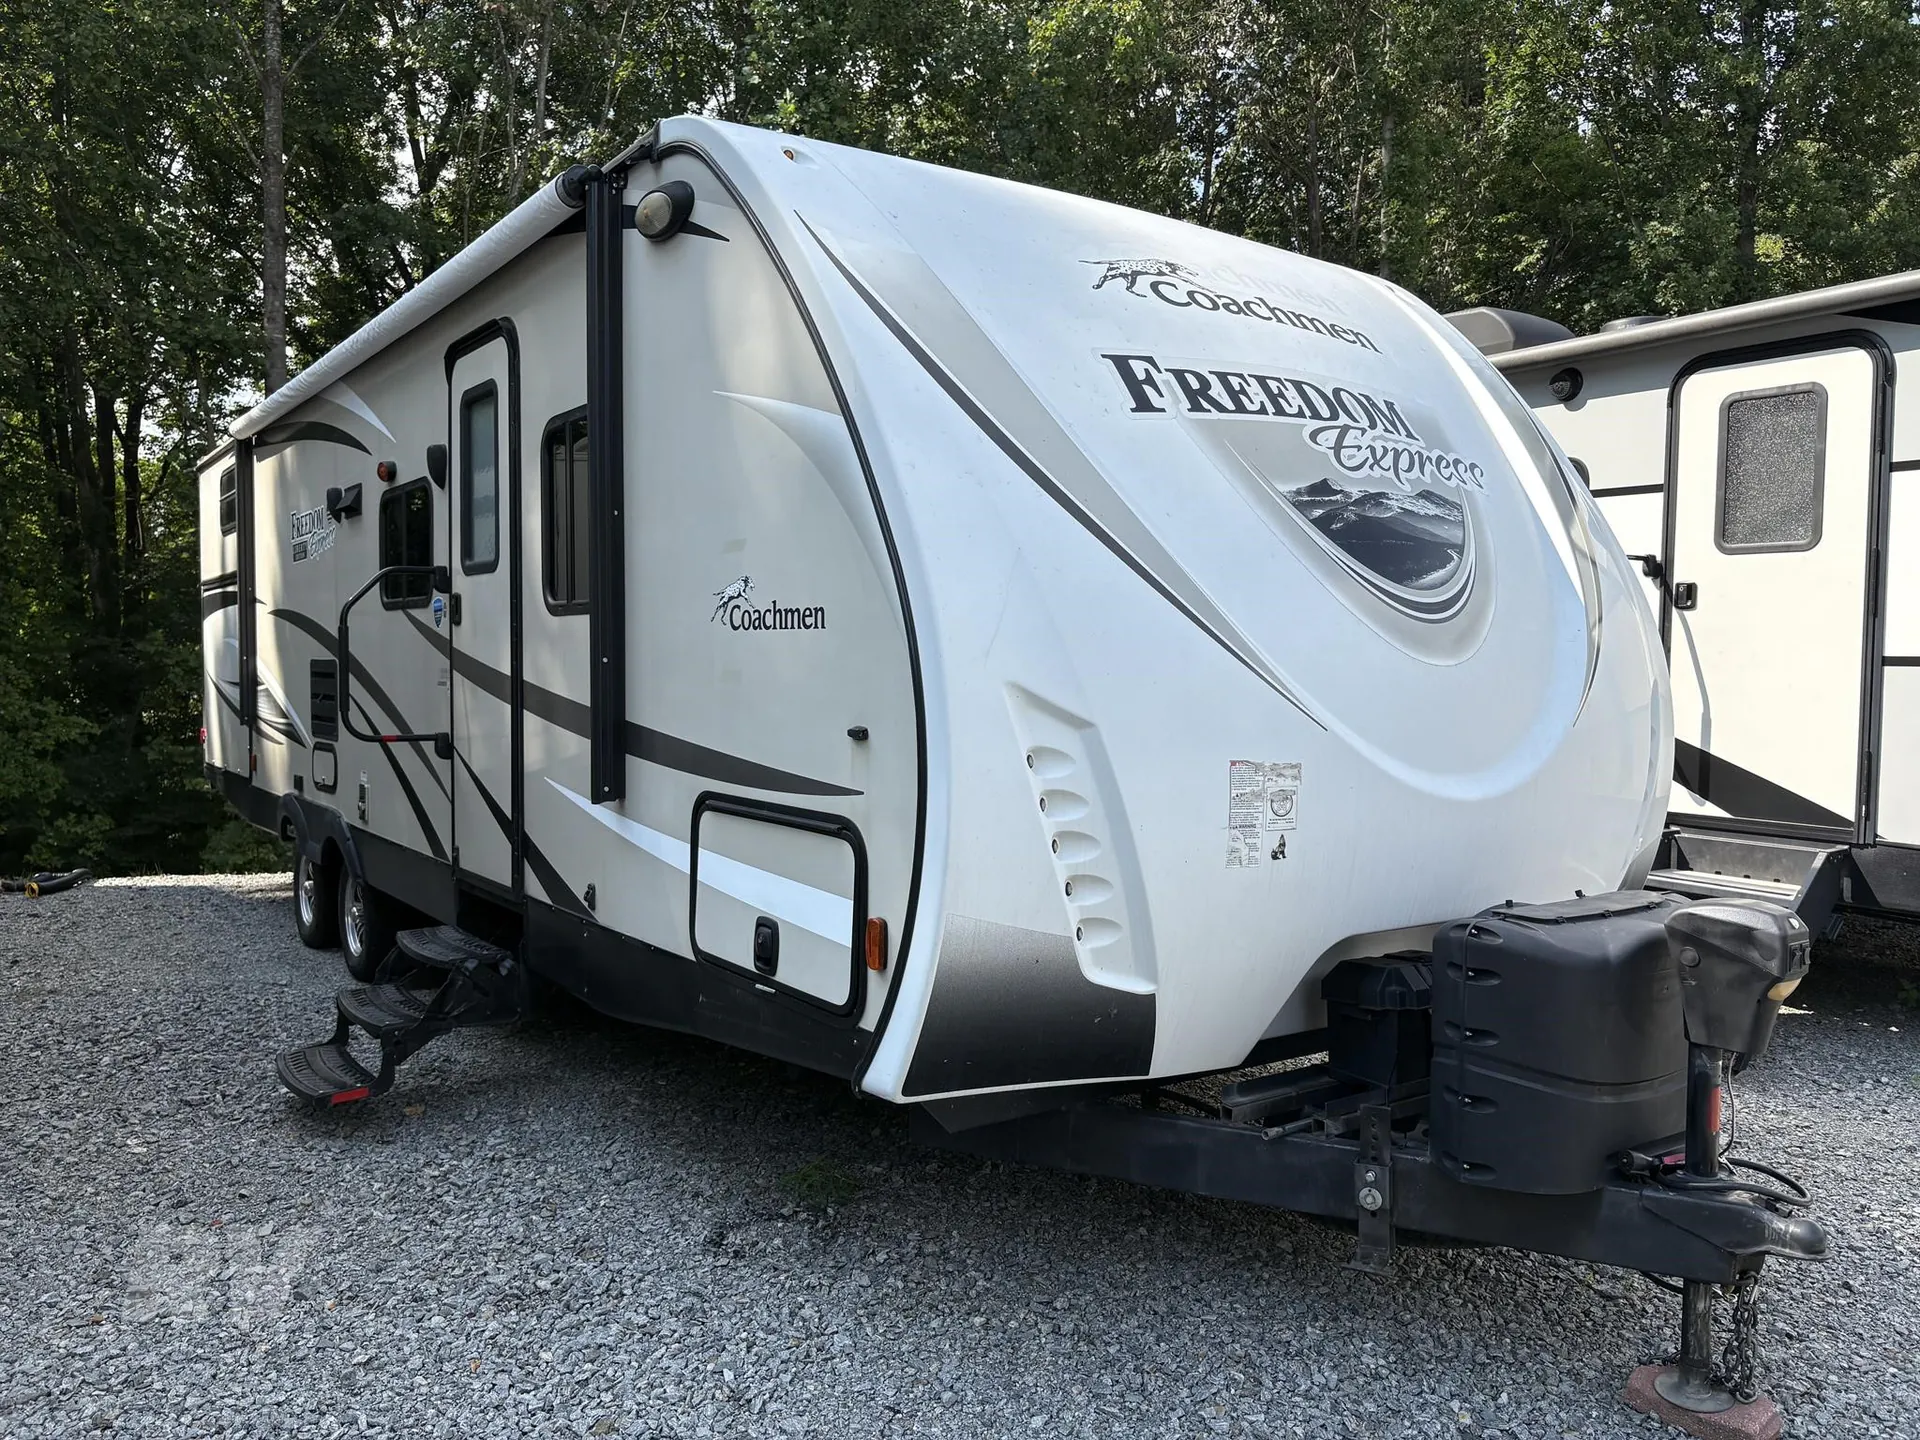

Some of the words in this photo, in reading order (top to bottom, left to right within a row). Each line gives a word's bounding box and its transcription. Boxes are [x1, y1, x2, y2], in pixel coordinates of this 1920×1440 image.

[1149, 280, 1384, 355] Coachmen
[1099, 353, 1420, 442] FREEDOM
[1308, 422, 1485, 490] Express
[291, 506, 325, 541] FREEDOM
[729, 599, 827, 631] Coachmen
